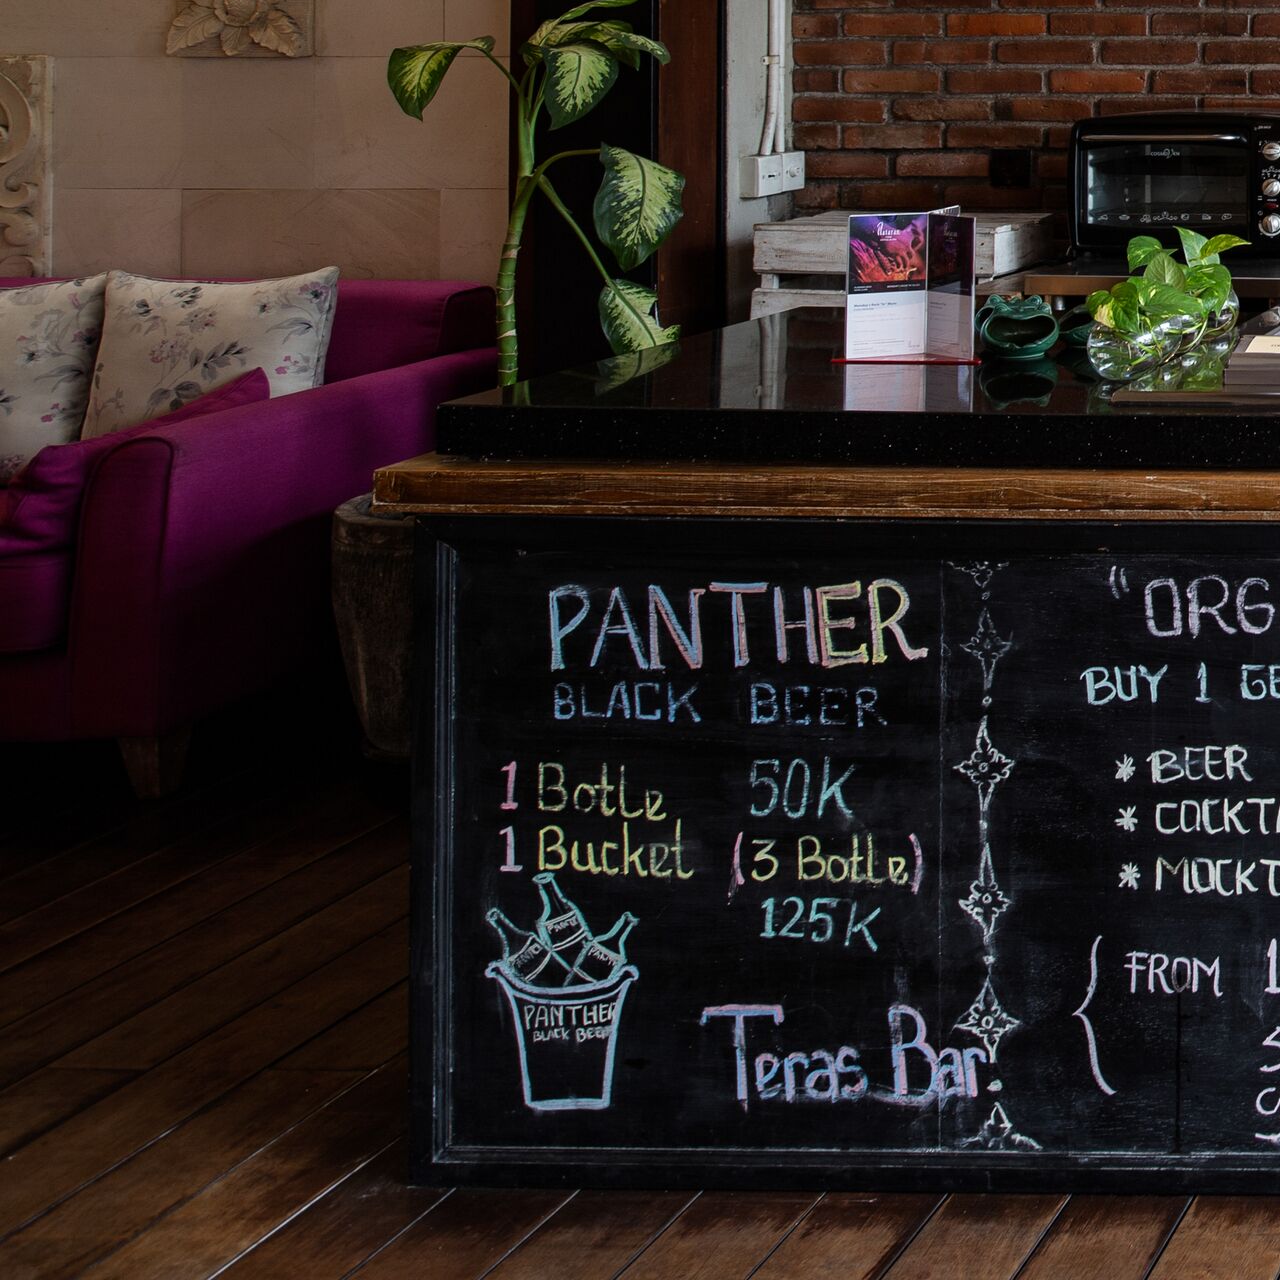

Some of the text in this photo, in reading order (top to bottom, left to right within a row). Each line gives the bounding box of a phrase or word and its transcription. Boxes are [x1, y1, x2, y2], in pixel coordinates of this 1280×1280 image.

[549, 577, 928, 670] PANTHER
[554, 682, 888, 727] BLACK BEER
[1080, 665, 1168, 706] BUY
[1196, 665, 1210, 705] 1
[500, 755, 856, 821] 1 Botle 50K
[1147, 745, 1253, 783] BEER
[499, 826, 523, 873] 1
[537, 819, 695, 881] Bucket
[760, 896, 882, 953] 125K
[1124, 950, 1224, 997] FROM
[701, 1002, 993, 1110] Teras Bar
